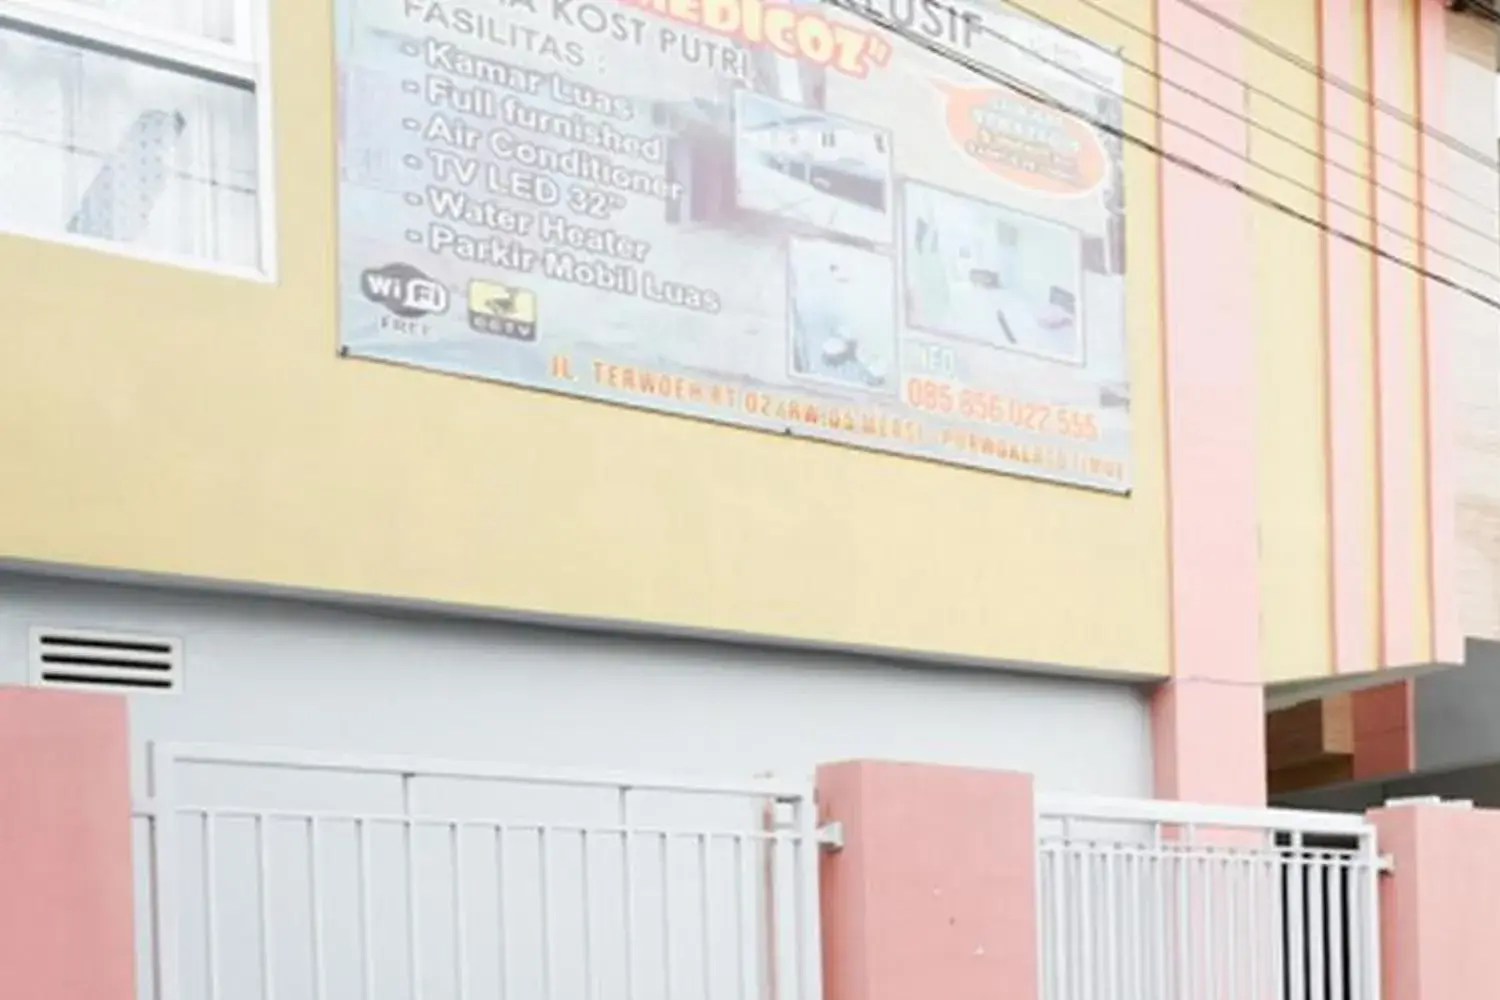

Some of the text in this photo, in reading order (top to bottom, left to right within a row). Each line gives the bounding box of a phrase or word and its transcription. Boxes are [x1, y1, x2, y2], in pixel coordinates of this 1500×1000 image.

[424, 37, 635, 121] Kamar Luas
[552, 0, 749, 77] KOST PUTRI
[424, 112, 684, 202] Air Conditioner
[426, 74, 665, 163] Full furnished
[429, 150, 478, 186] TV
[488, 164, 560, 207] LED
[427, 187, 652, 262] Water Heater
[429, 223, 721, 313] Parkir Mobil Luas
